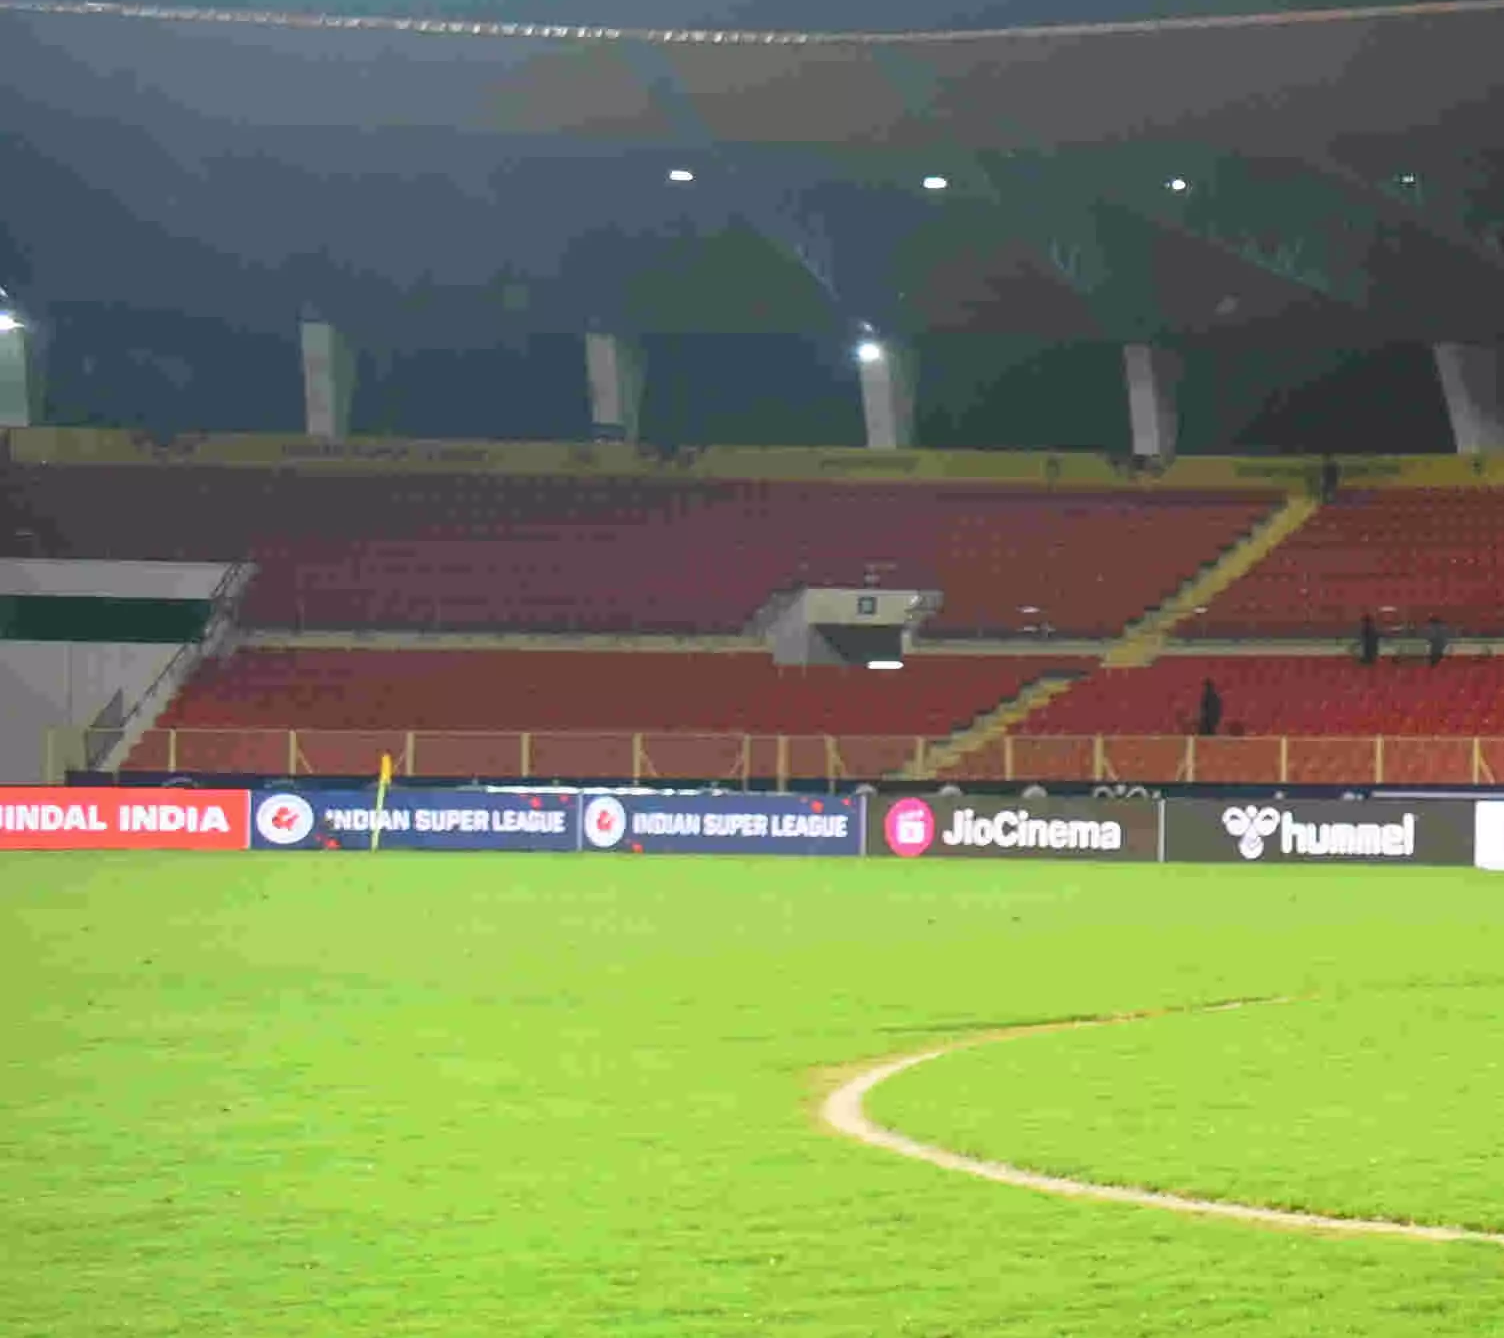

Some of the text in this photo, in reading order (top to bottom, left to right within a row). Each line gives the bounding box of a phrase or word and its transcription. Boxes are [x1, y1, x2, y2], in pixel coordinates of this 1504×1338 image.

[119, 805, 230, 832] INDIA
[415, 809, 489, 832] SUPER
[492, 810, 566, 832] LEAGUE
[703, 814, 768, 836] SUPER
[771, 815, 848, 837] LEAGUE
[943, 808, 1121, 849] JioCinema
[1281, 811, 1415, 855] hummel
